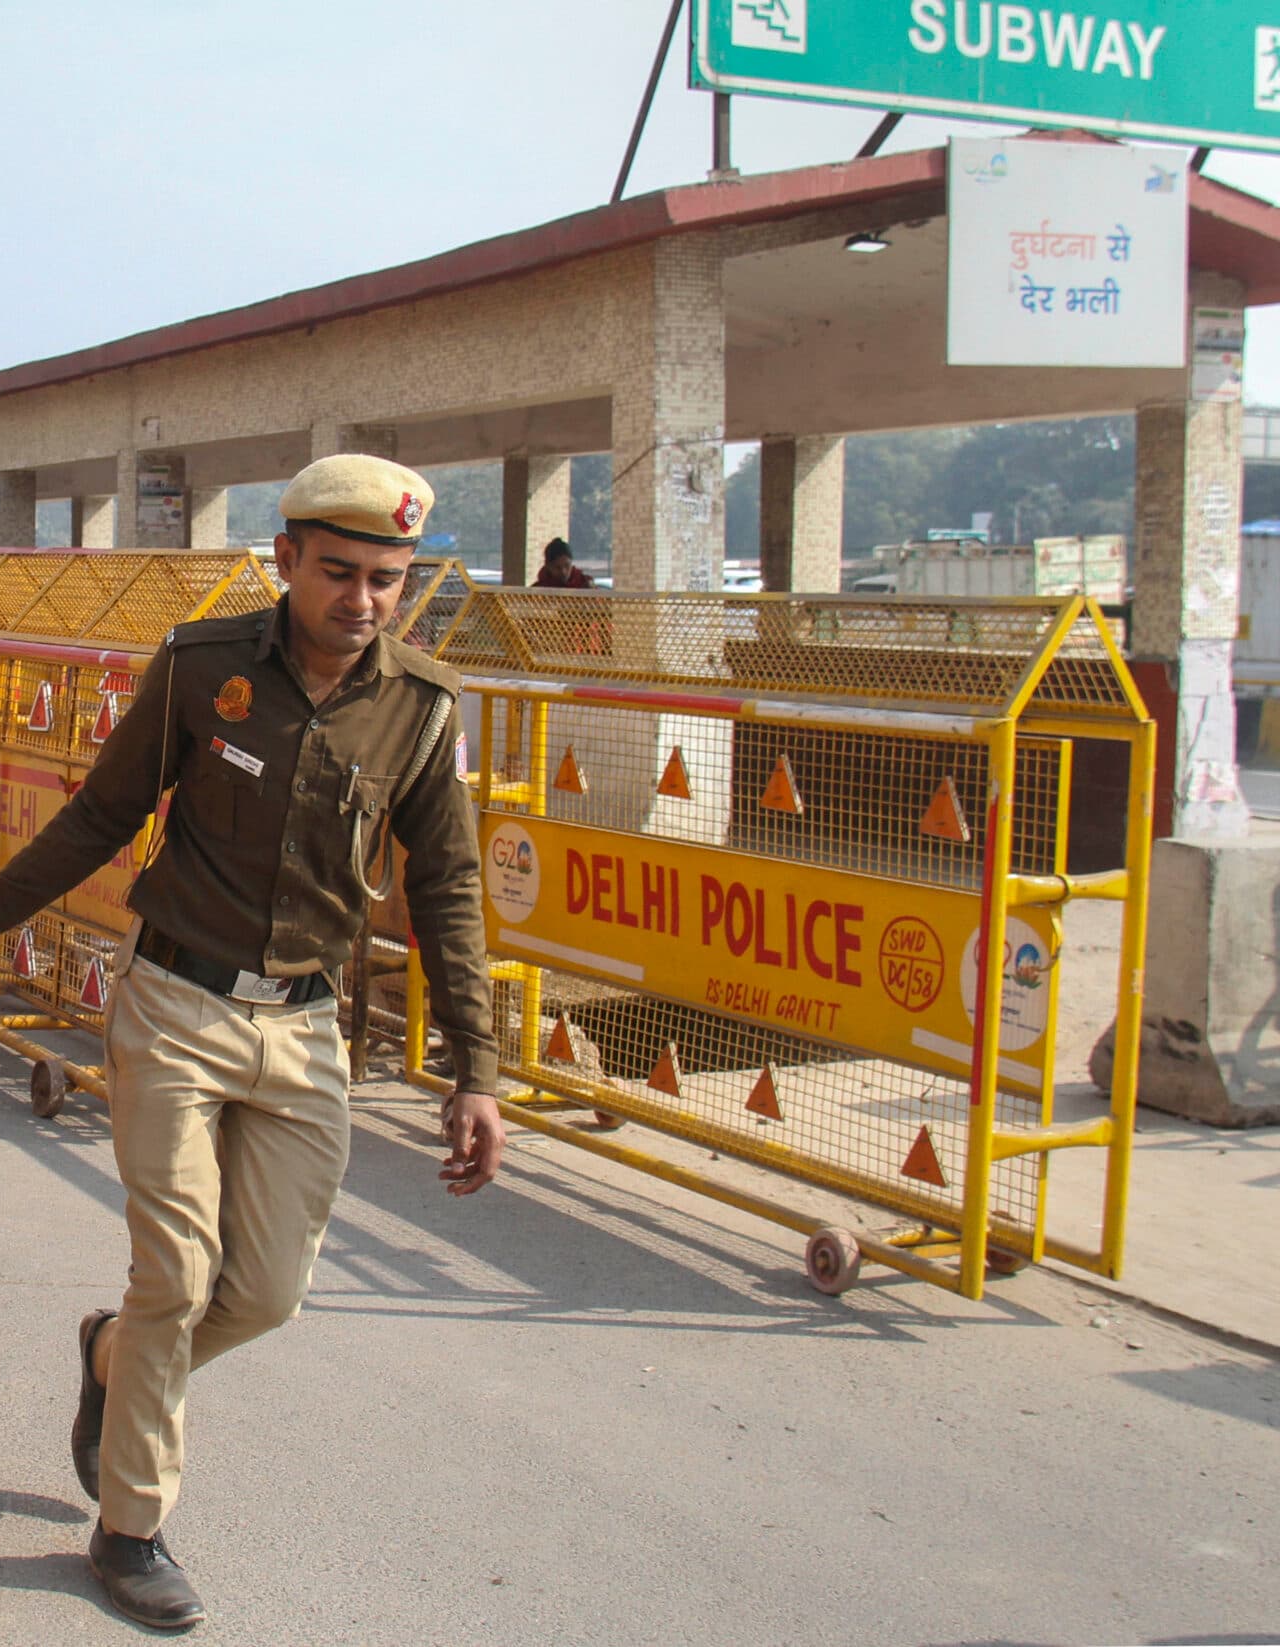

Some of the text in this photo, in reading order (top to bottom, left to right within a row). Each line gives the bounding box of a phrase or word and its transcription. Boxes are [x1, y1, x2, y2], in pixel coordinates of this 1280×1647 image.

[908, 0, 1167, 80] SUBWAY
[1008, 218, 1131, 271] दुर्घटना से
[1019, 274, 1120, 314] देर भली
[566, 847, 680, 937] DELHI
[700, 873, 864, 988] POLICE
